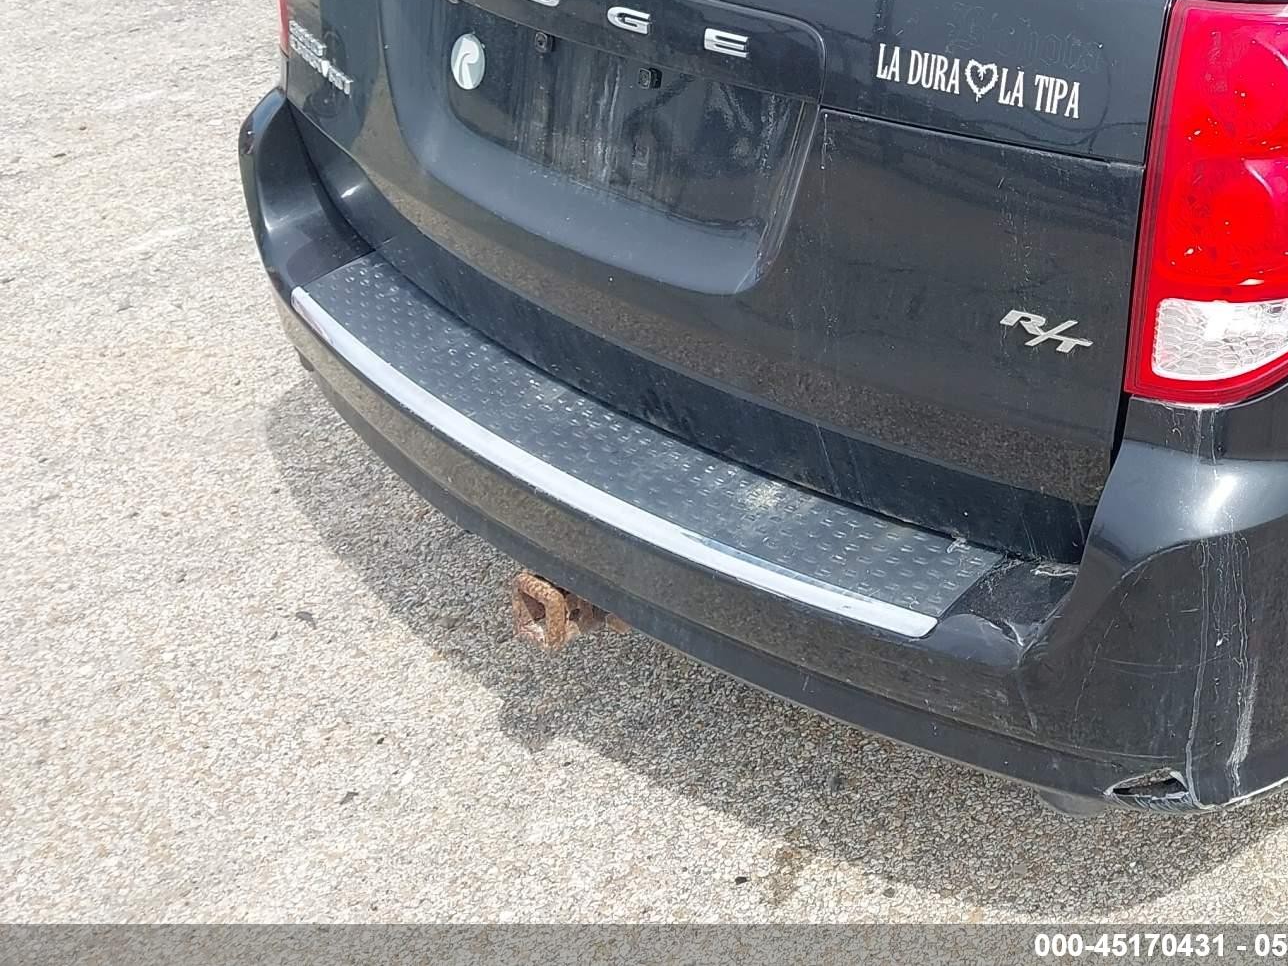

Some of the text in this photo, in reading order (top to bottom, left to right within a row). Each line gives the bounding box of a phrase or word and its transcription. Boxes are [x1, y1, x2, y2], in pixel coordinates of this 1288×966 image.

[876, 43, 1081, 119] LA DURA LA TIPA
[1000, 309, 1094, 354] R/T
